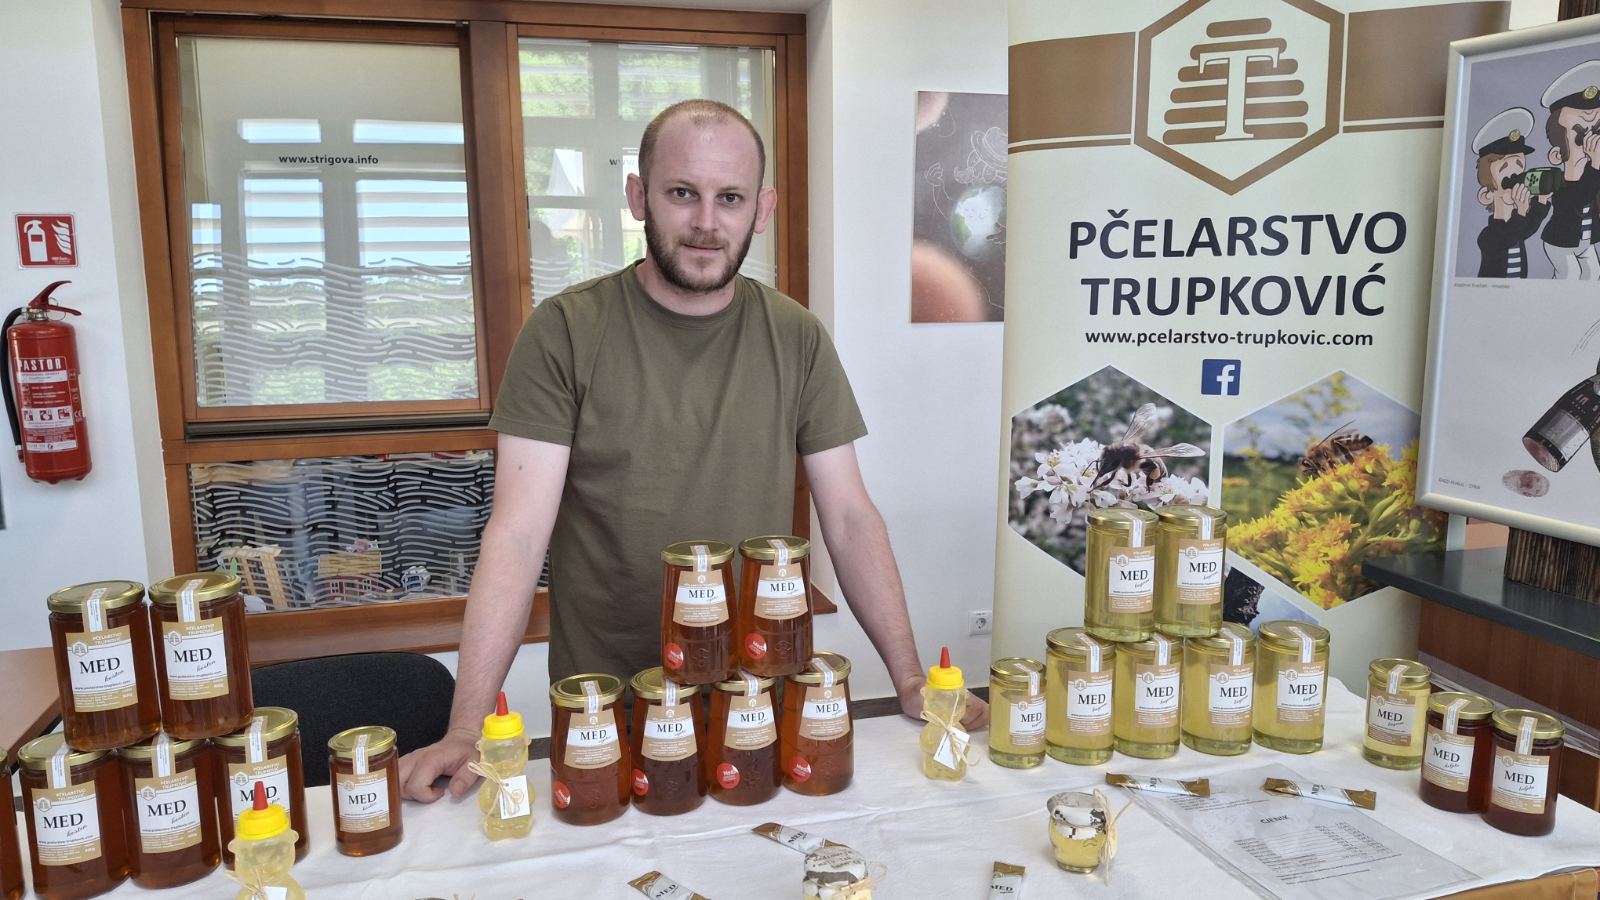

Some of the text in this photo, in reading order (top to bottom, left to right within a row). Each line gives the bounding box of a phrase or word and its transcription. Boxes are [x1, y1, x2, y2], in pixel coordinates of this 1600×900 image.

[279, 153, 379, 166] www.strigova.info
[1069, 208, 1407, 260] PČELARSTVO
[1080, 262, 1386, 317] TRUPKOVIĆ
[1085, 328, 1374, 347] www.pcelarstvo-trupkovic.com
[18, 358, 62, 371] PASTOR
[1189, 561, 1217, 573] MED
[1120, 570, 1148, 581] MED
[770, 582, 795, 592] MED
[688, 589, 715, 599] MED
[174, 647, 212, 663] MED
[79, 657, 120, 675] MED
[1145, 686, 1174, 698] MED
[1220, 686, 1247, 698] MED
[1288, 683, 1318, 695] MED
[1078, 693, 1106, 705] MED
[815, 703, 840, 713] MED
[740, 711, 765, 722] MED
[1020, 712, 1042, 723] MED
[1377, 708, 1403, 722] MED
[657, 723, 683, 733] MED
[580, 729, 607, 741] MED
[1433, 746, 1460, 762] MED
[1504, 770, 1535, 785] MED
[240, 785, 277, 802] MD
[348, 792, 377, 805] MED
[147, 799, 187, 817] MED
[43, 812, 84, 829] MED
[655, 884, 677, 898] MED
